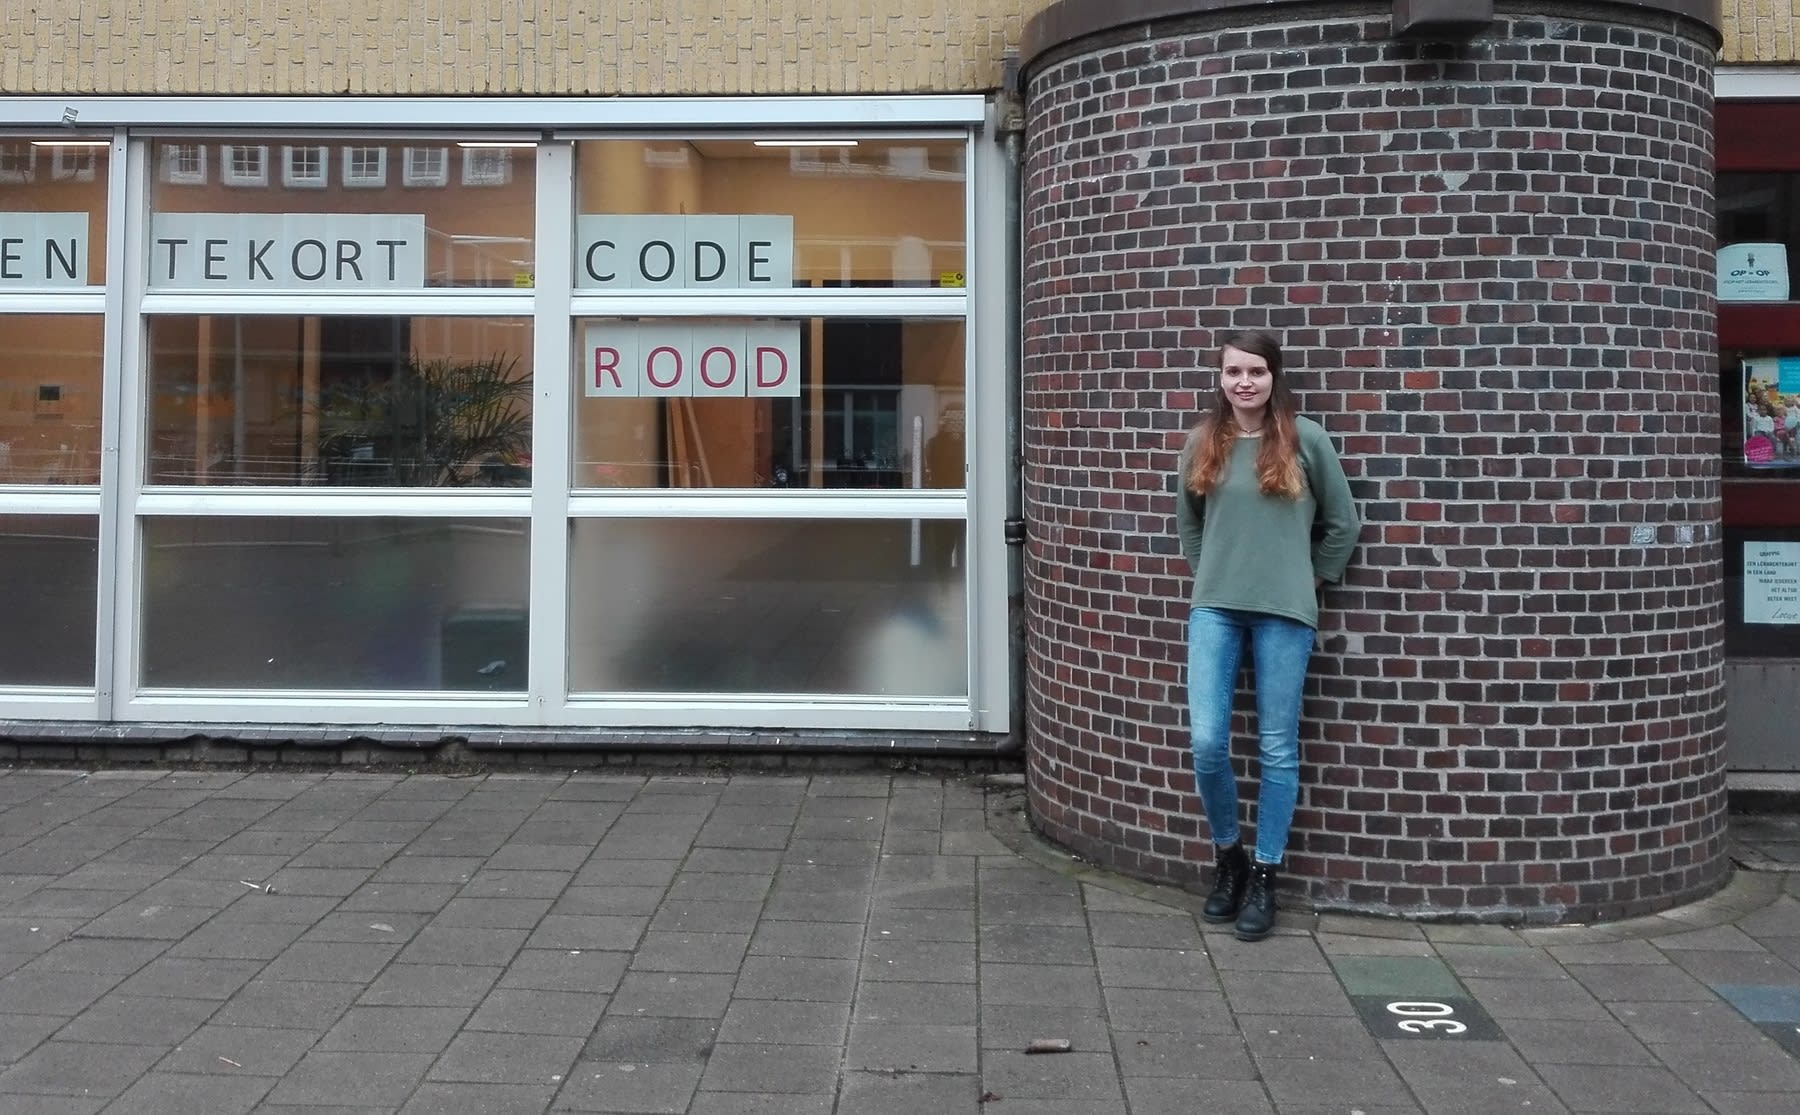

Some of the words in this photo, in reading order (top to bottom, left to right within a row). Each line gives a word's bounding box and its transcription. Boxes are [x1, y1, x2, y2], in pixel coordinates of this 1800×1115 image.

[157, 238, 407, 281] TEKORT
[585, 240, 772, 282] CODE
[594, 346, 788, 389] ROOD
[1386, 1001, 1468, 1034] 30
